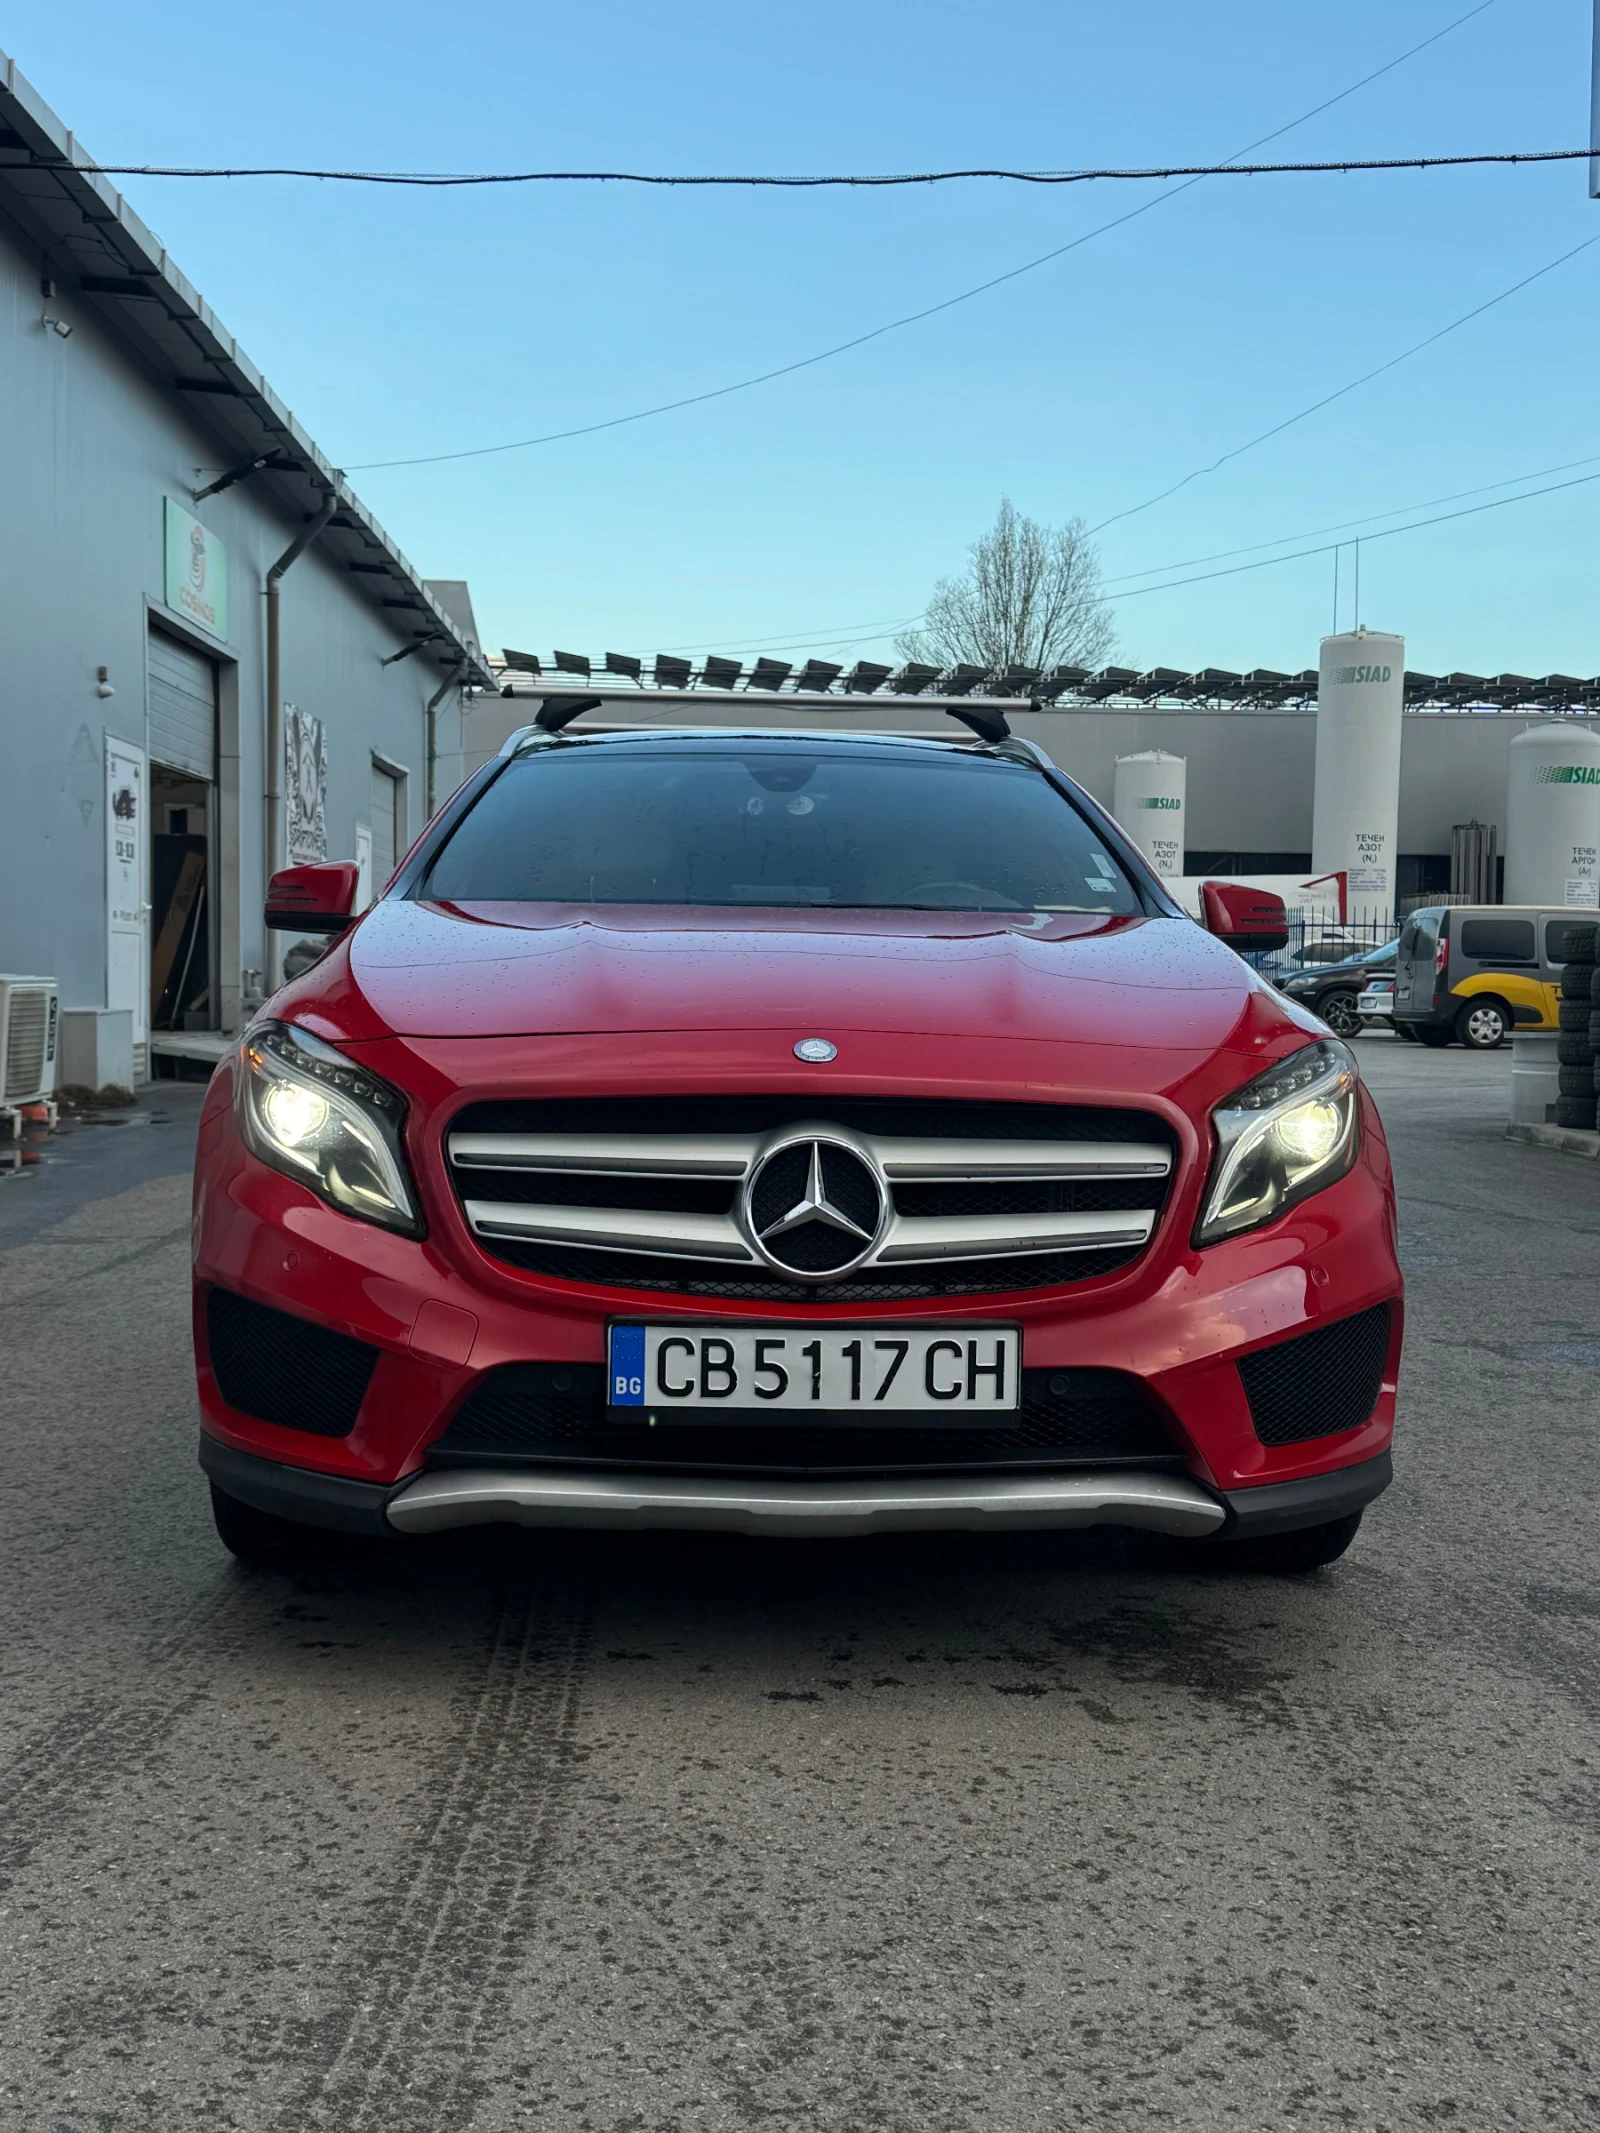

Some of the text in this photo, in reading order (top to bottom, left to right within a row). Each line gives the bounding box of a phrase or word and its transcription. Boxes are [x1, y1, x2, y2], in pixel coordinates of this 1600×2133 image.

[1356, 666, 1391, 682] SIAD
[1159, 798, 1181, 809] SIAD
[1355, 834, 1385, 842] ТЕЧЕН
[1152, 841, 1178, 849] ТЕЧЕН
[1358, 843, 1382, 851] АЗОТ
[1155, 850, 1176, 859] АЗОТ
[1572, 847, 1596, 855] ТЕЧЕН
[1572, 857, 1596, 865] АРГОН
[754, 1338, 909, 1401] 5117
[615, 1376, 641, 1396] BG
